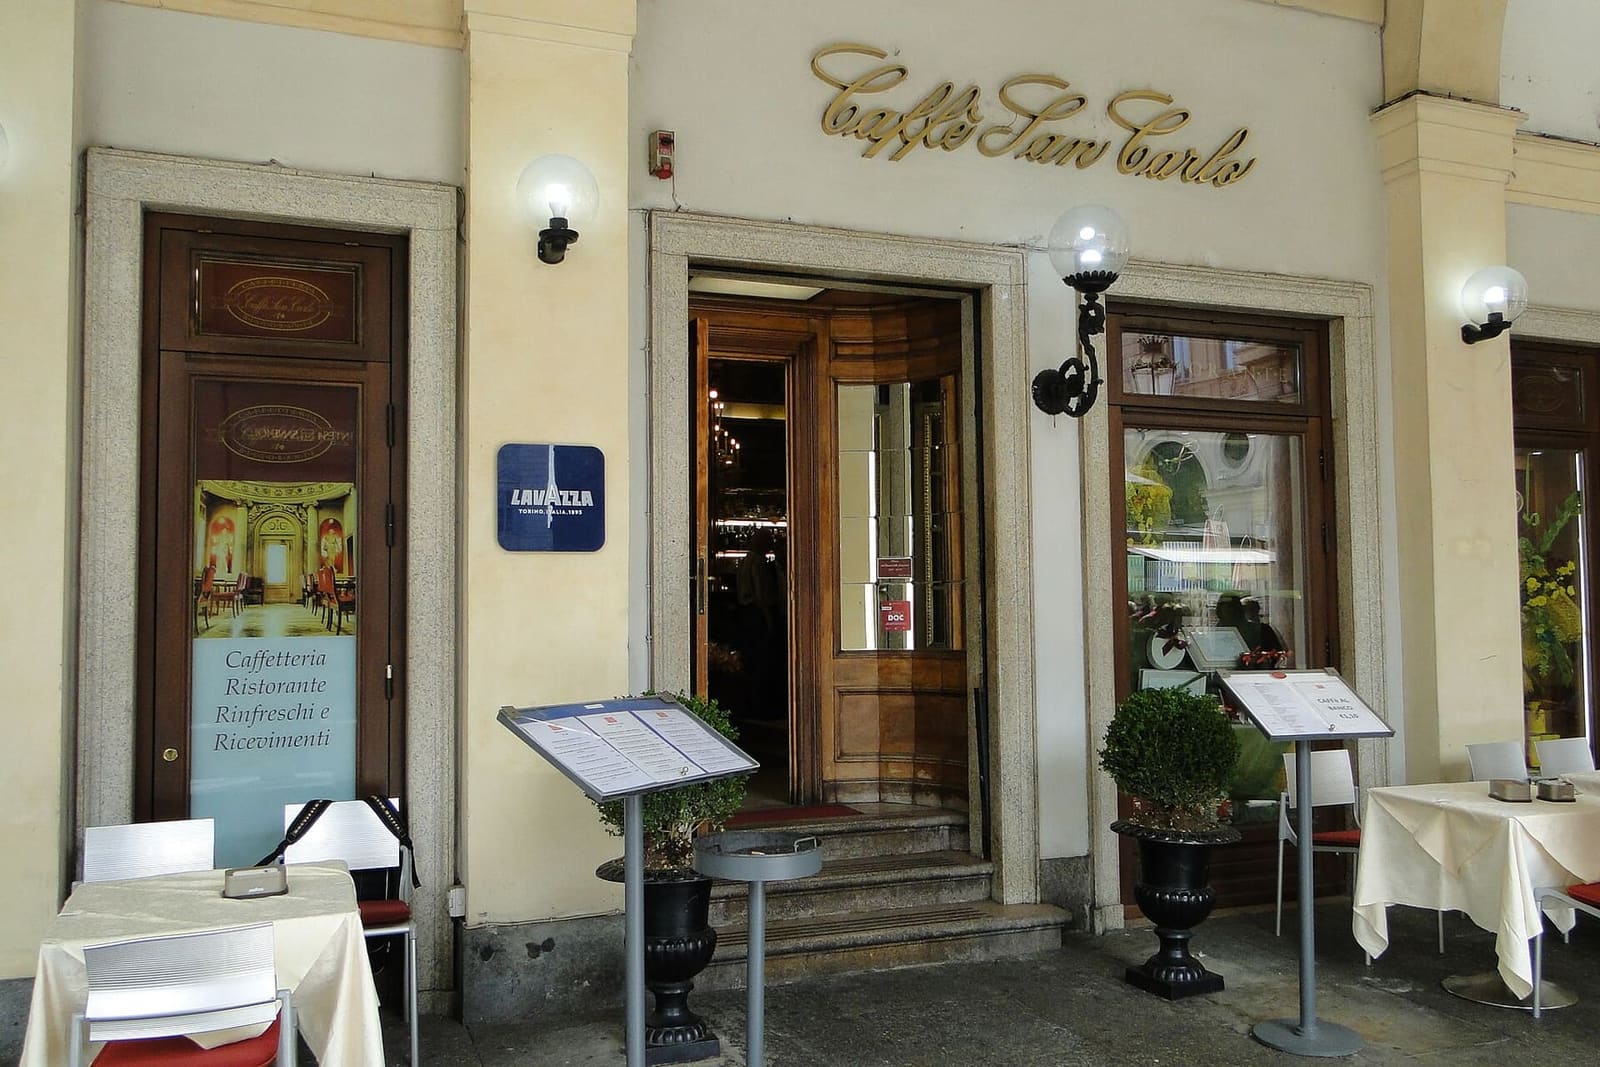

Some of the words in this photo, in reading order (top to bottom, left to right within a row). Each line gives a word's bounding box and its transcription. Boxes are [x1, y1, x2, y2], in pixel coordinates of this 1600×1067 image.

[811, 42, 984, 162] Caffè
[977, 73, 1110, 169] San
[1106, 89, 1257, 188] Carlo
[511, 485, 594, 506] LAVAZZA
[225, 649, 327, 673] Caffetteria
[225, 678, 327, 696] Ristorante
[215, 703, 315, 728] Rinfreschi
[320, 707, 330, 720] e
[214, 729, 331, 751] Ricevimenti
